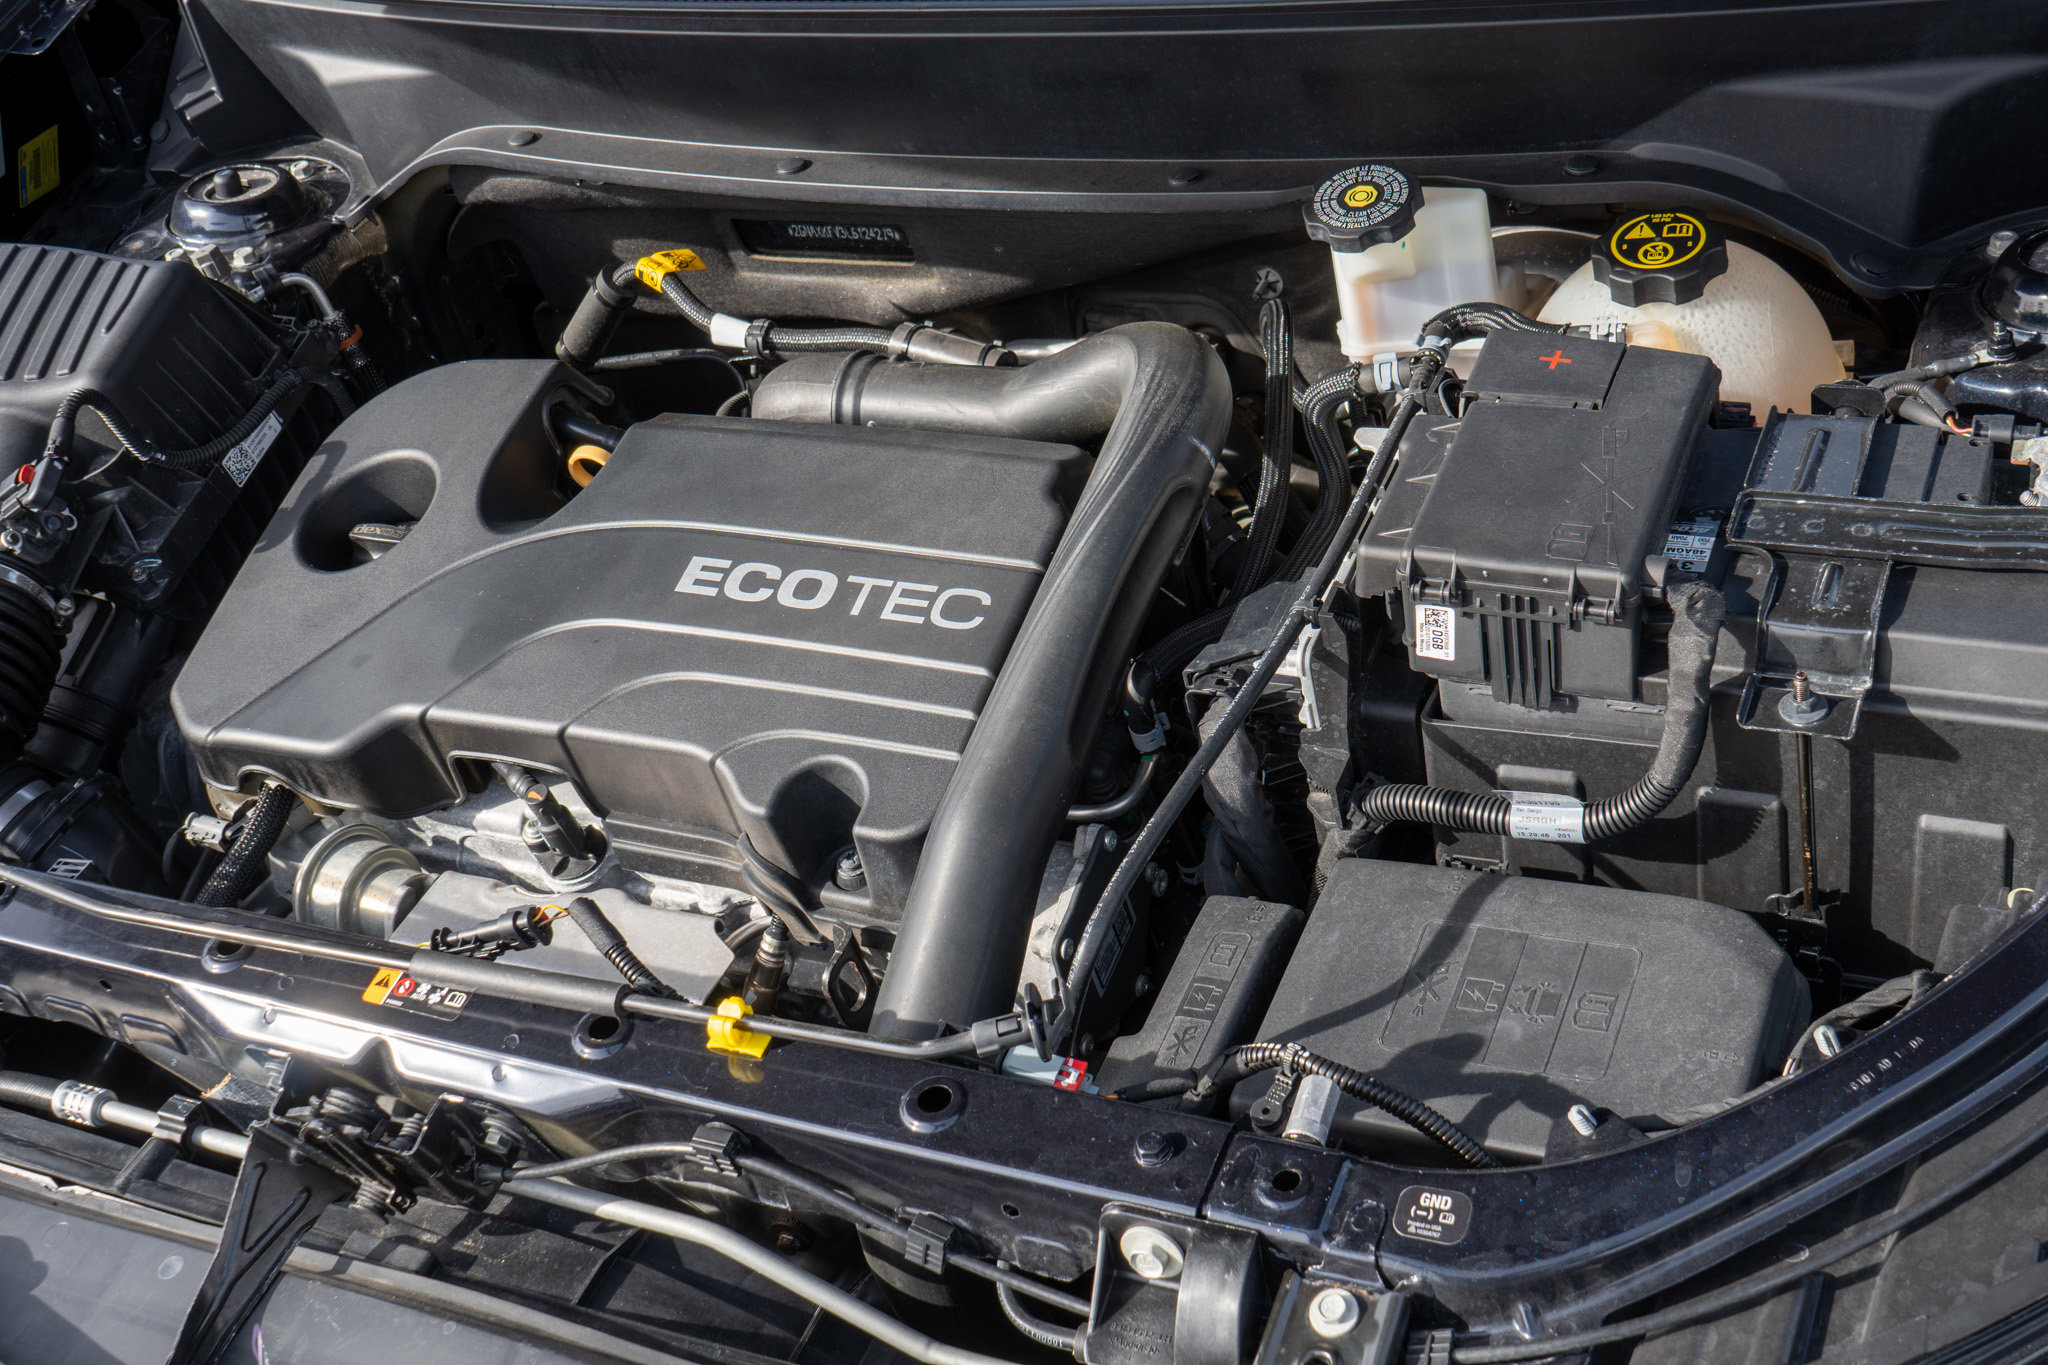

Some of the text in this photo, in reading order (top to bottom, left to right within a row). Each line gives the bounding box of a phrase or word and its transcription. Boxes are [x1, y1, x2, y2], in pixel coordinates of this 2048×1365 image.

[1332, 166, 1360, 181] NETTOYER
[1370, 164, 1396, 174] BOUCHON
[1347, 210, 1368, 218] CLEAN
[1367, 201, 1387, 215] FILLER
[1346, 220, 1370, 229] SEALED
[1432, 629, 1444, 650] DGB
[409, 992, 427, 1001] AUTO
[1420, 1192, 1453, 1210] GND
[1430, 1224, 1442, 1232] USA
